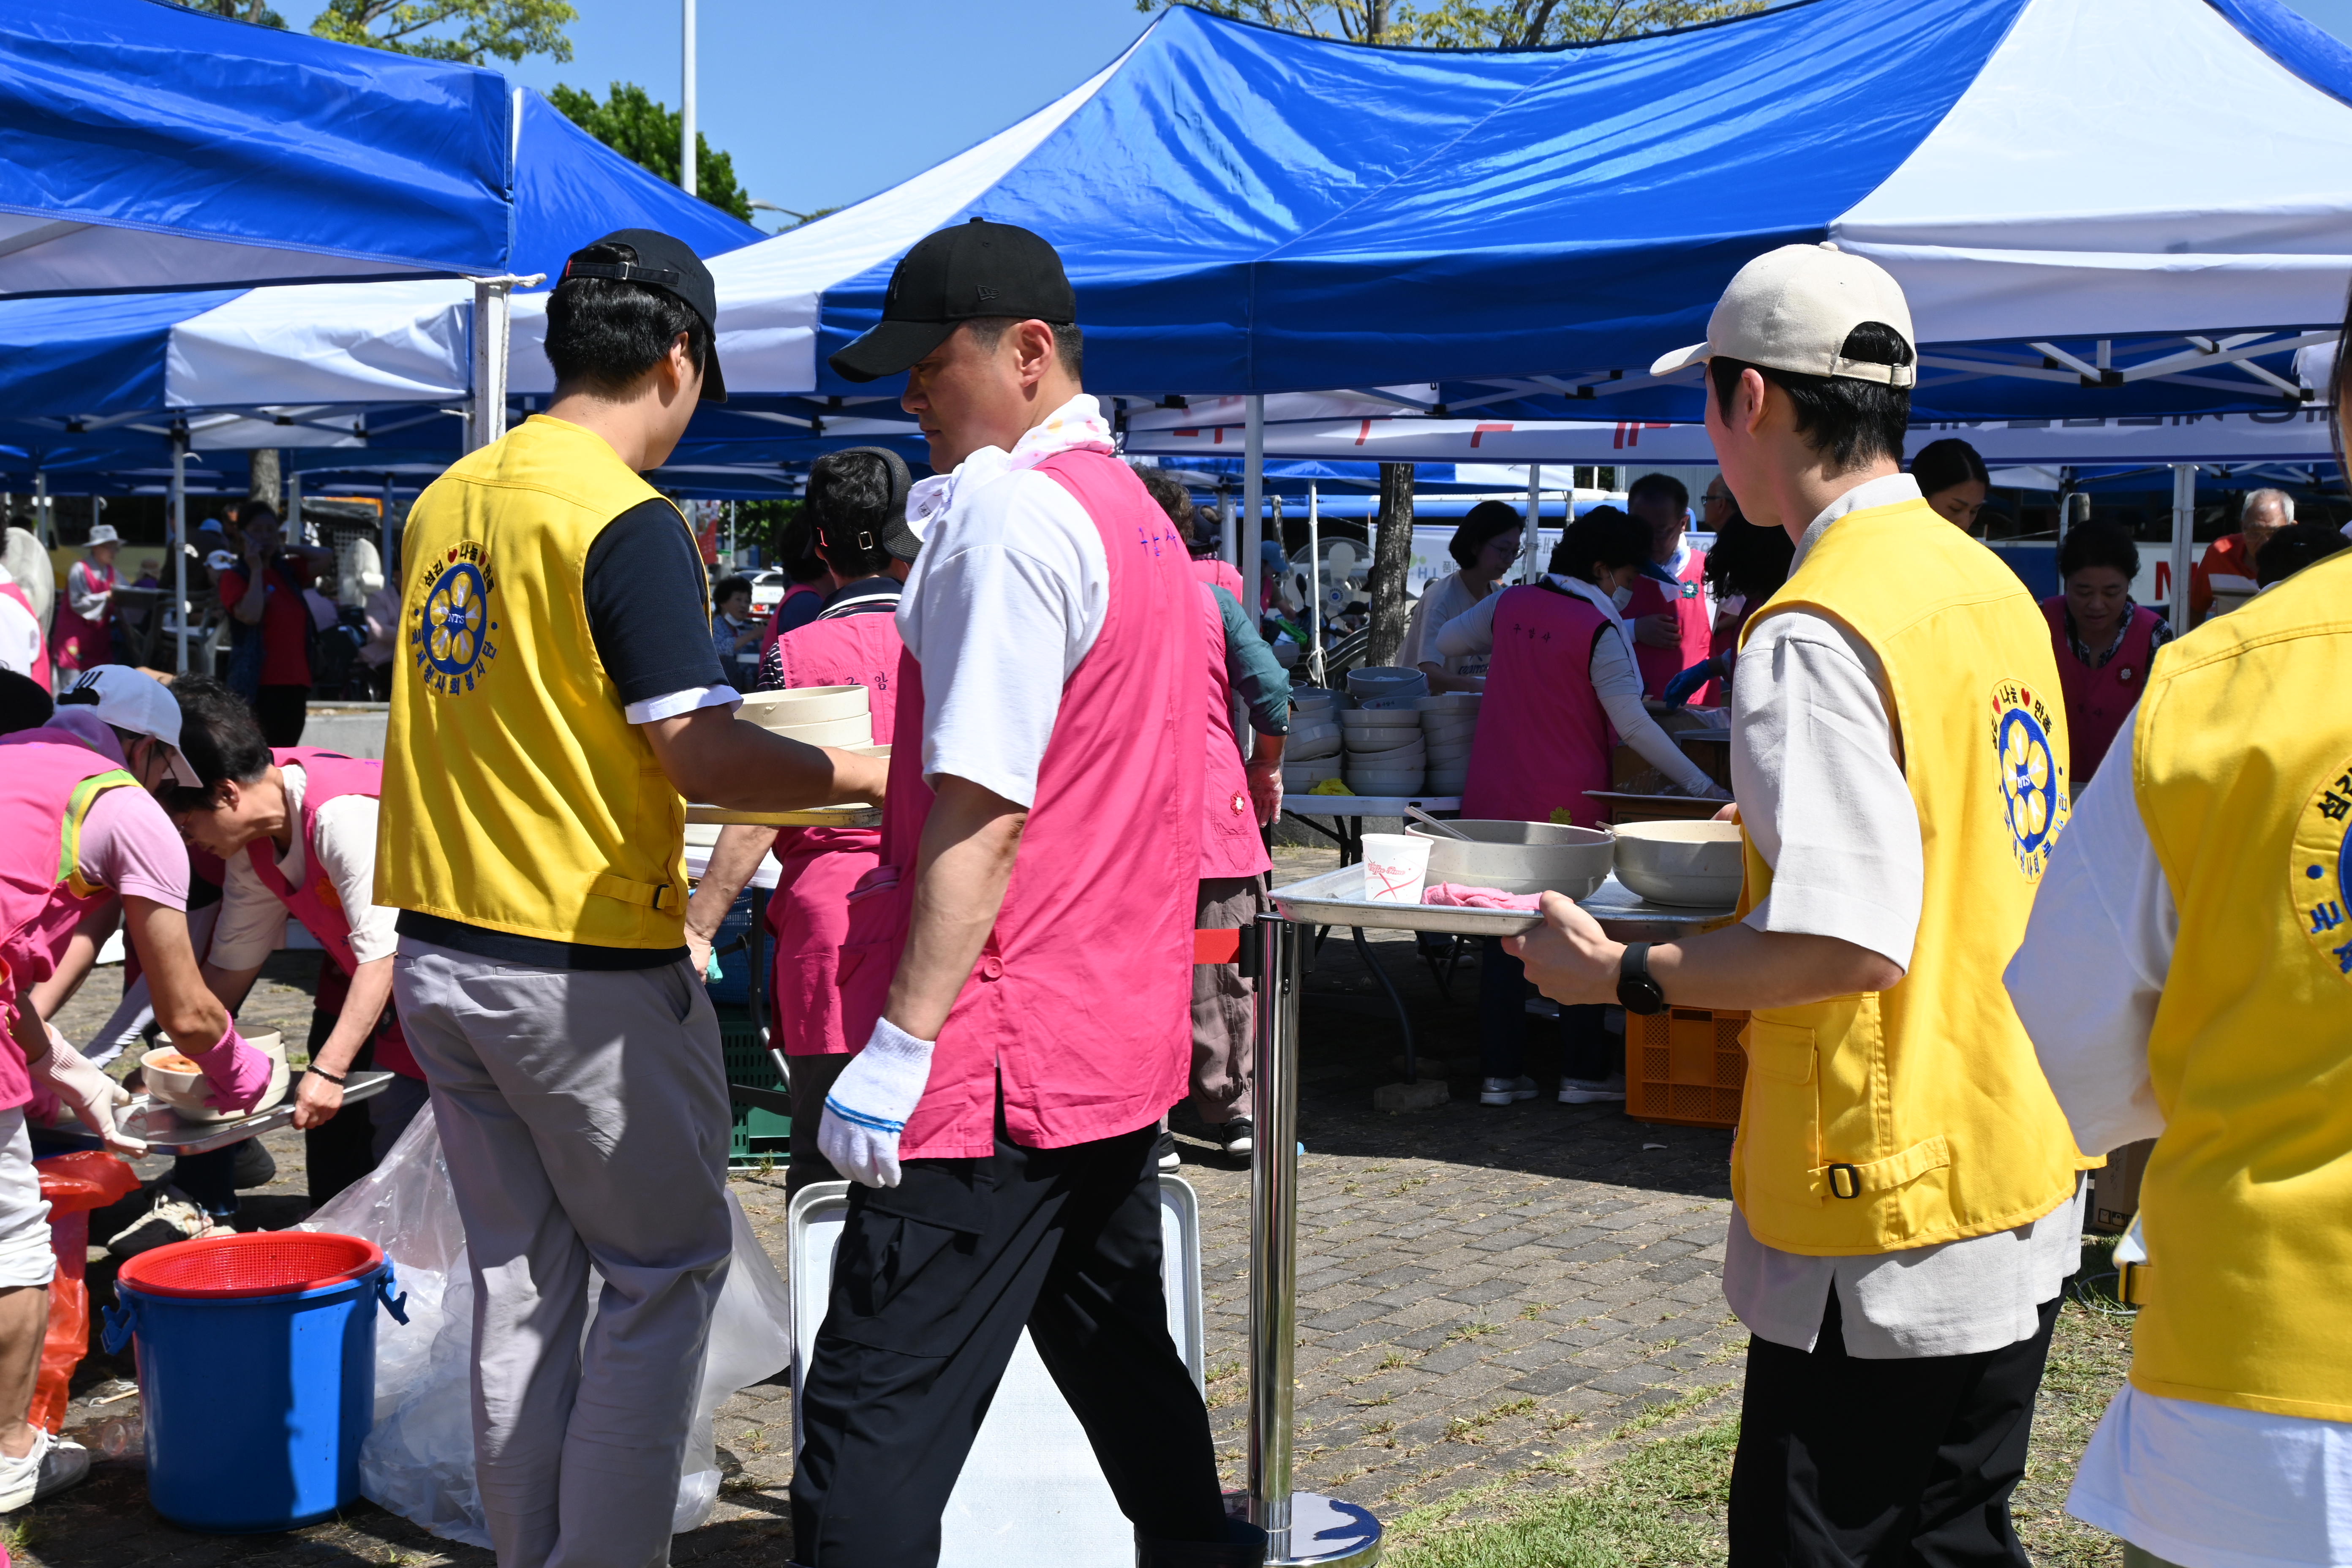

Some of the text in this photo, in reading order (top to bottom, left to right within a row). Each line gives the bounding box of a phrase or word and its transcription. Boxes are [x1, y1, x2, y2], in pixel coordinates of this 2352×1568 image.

[424, 544, 494, 594] 섬김 나눔 만족
[448, 613, 465, 624] NTS
[2000, 684, 2018, 705] 나눔
[2034, 700, 2053, 737] 만족
[2017, 773, 2030, 789] NTS
[1386, 866, 1406, 875] Time
